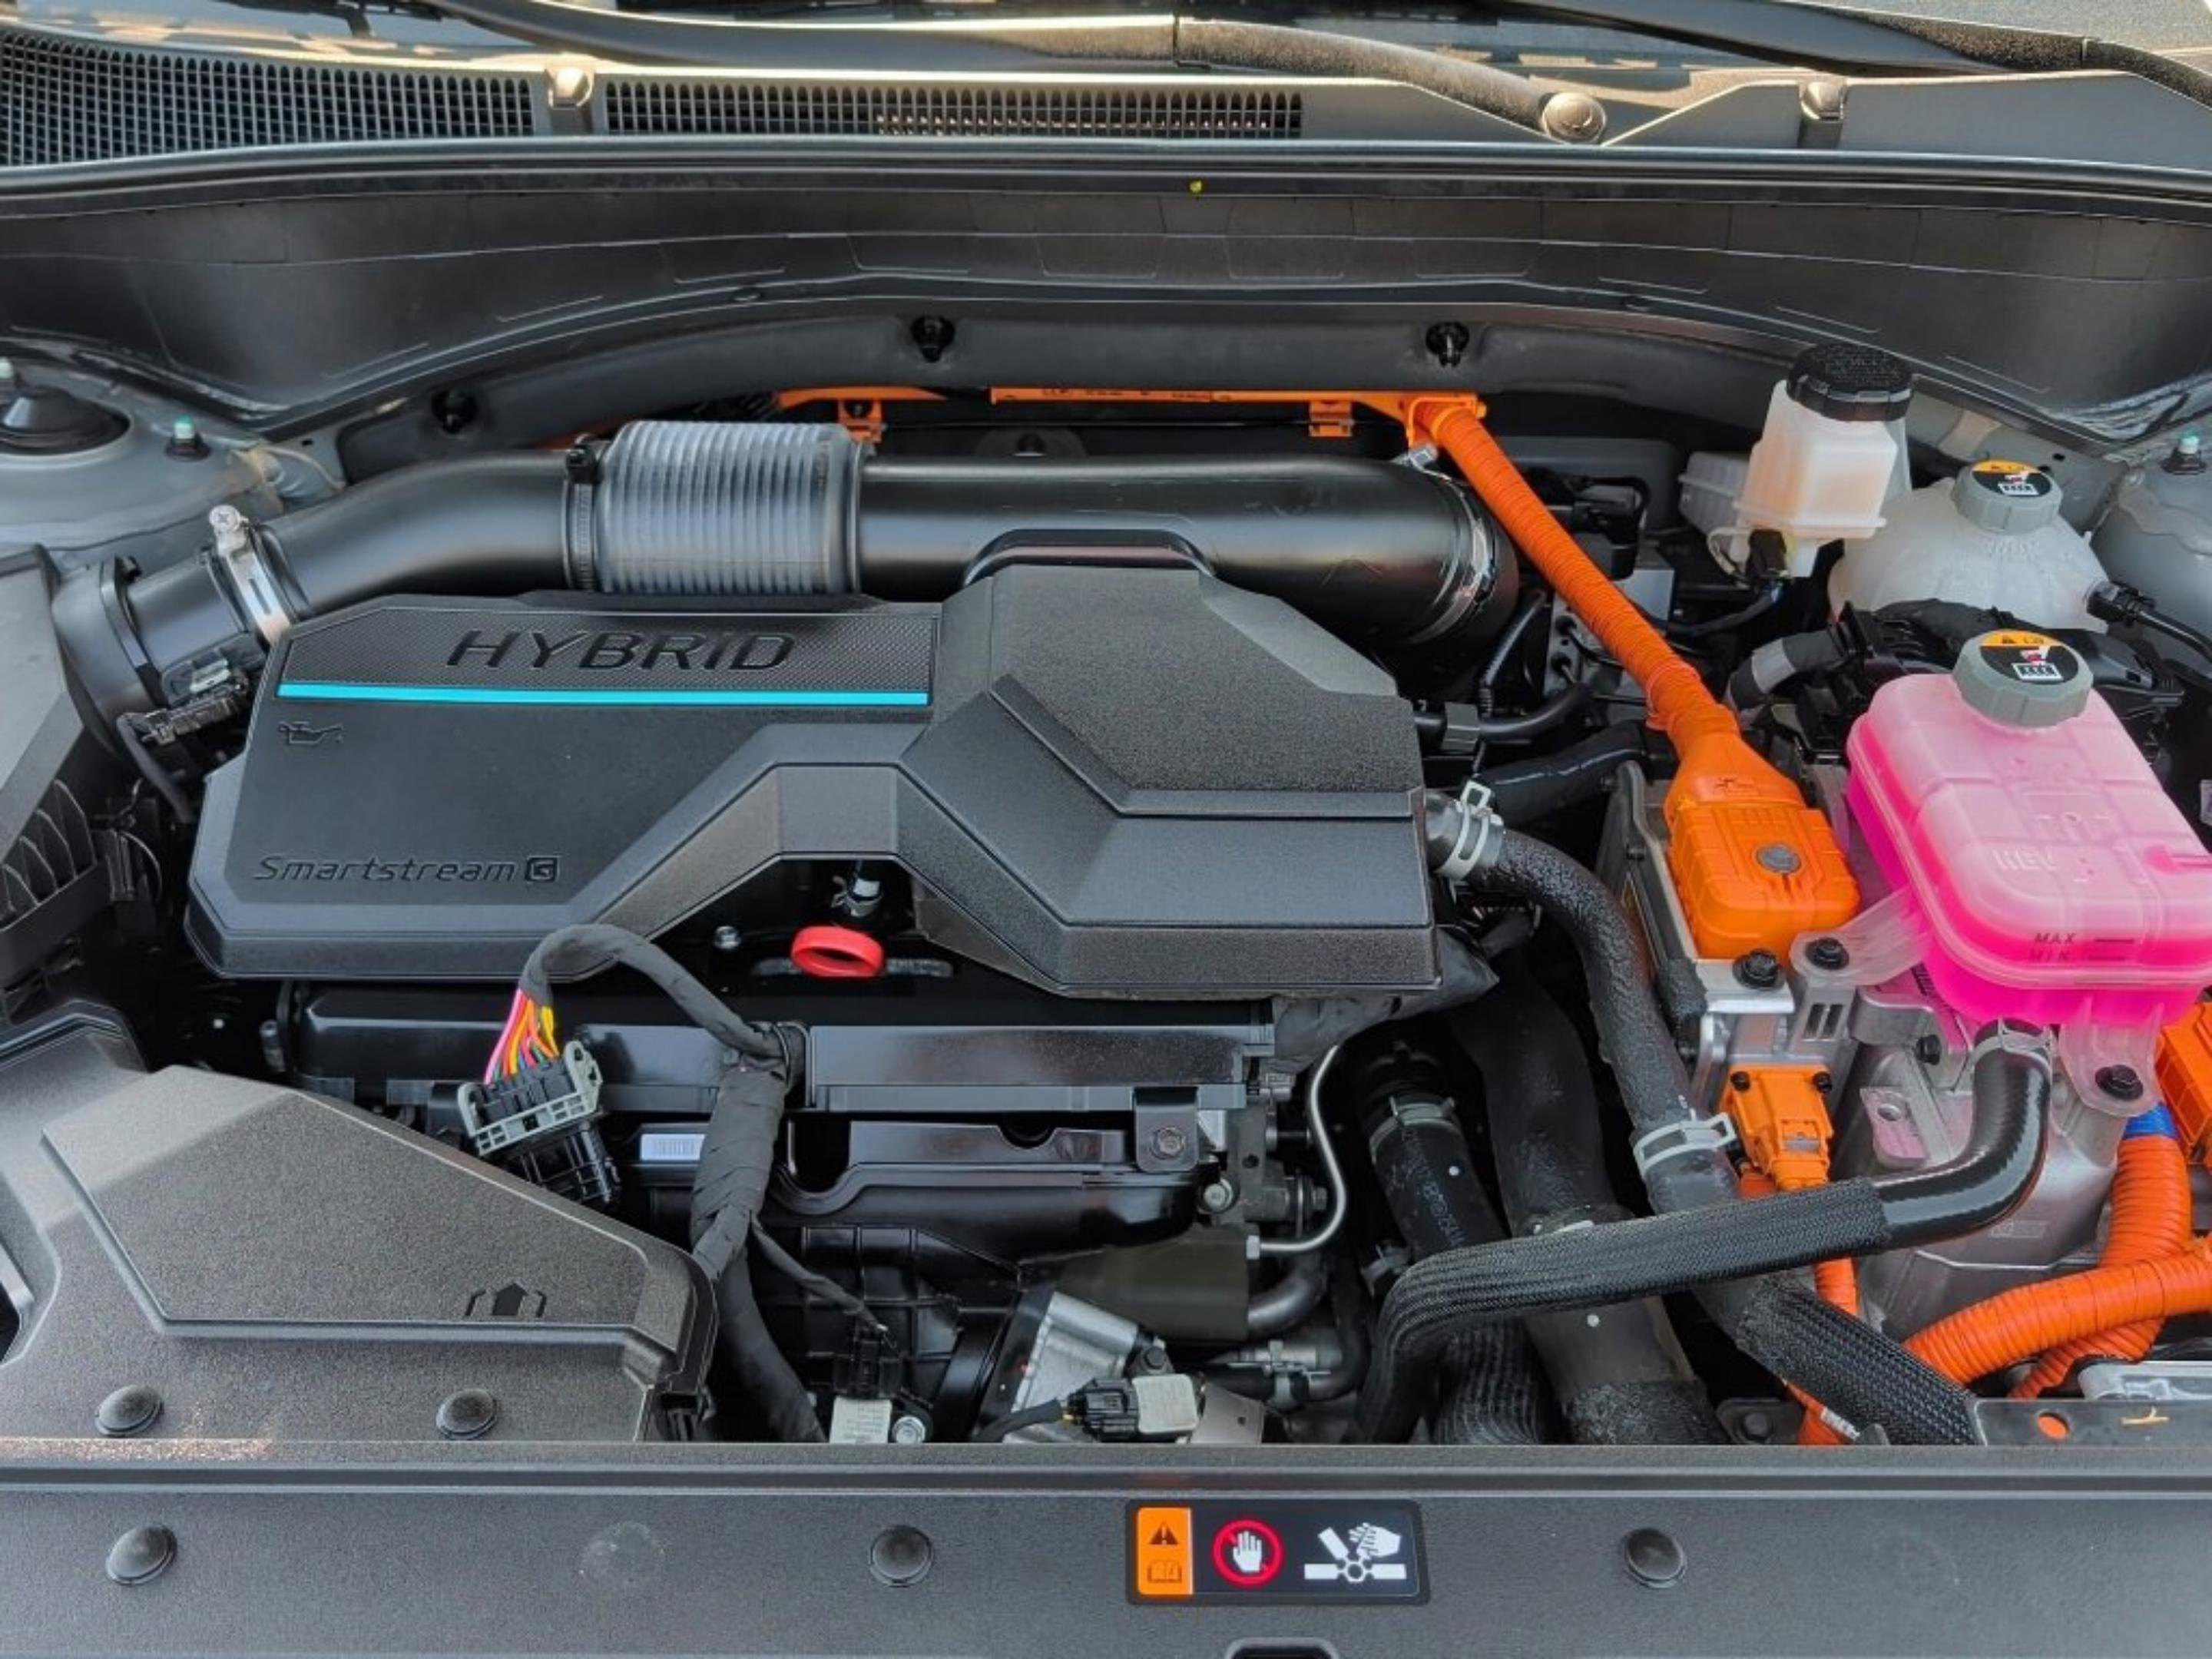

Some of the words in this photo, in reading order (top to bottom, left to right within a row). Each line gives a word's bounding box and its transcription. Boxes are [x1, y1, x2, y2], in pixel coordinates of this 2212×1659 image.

[445, 630, 796, 670] HYBRID
[253, 854, 518, 882] Smartstream
[2035, 932, 2076, 944] MAX
[2028, 949, 2071, 962] MIN
